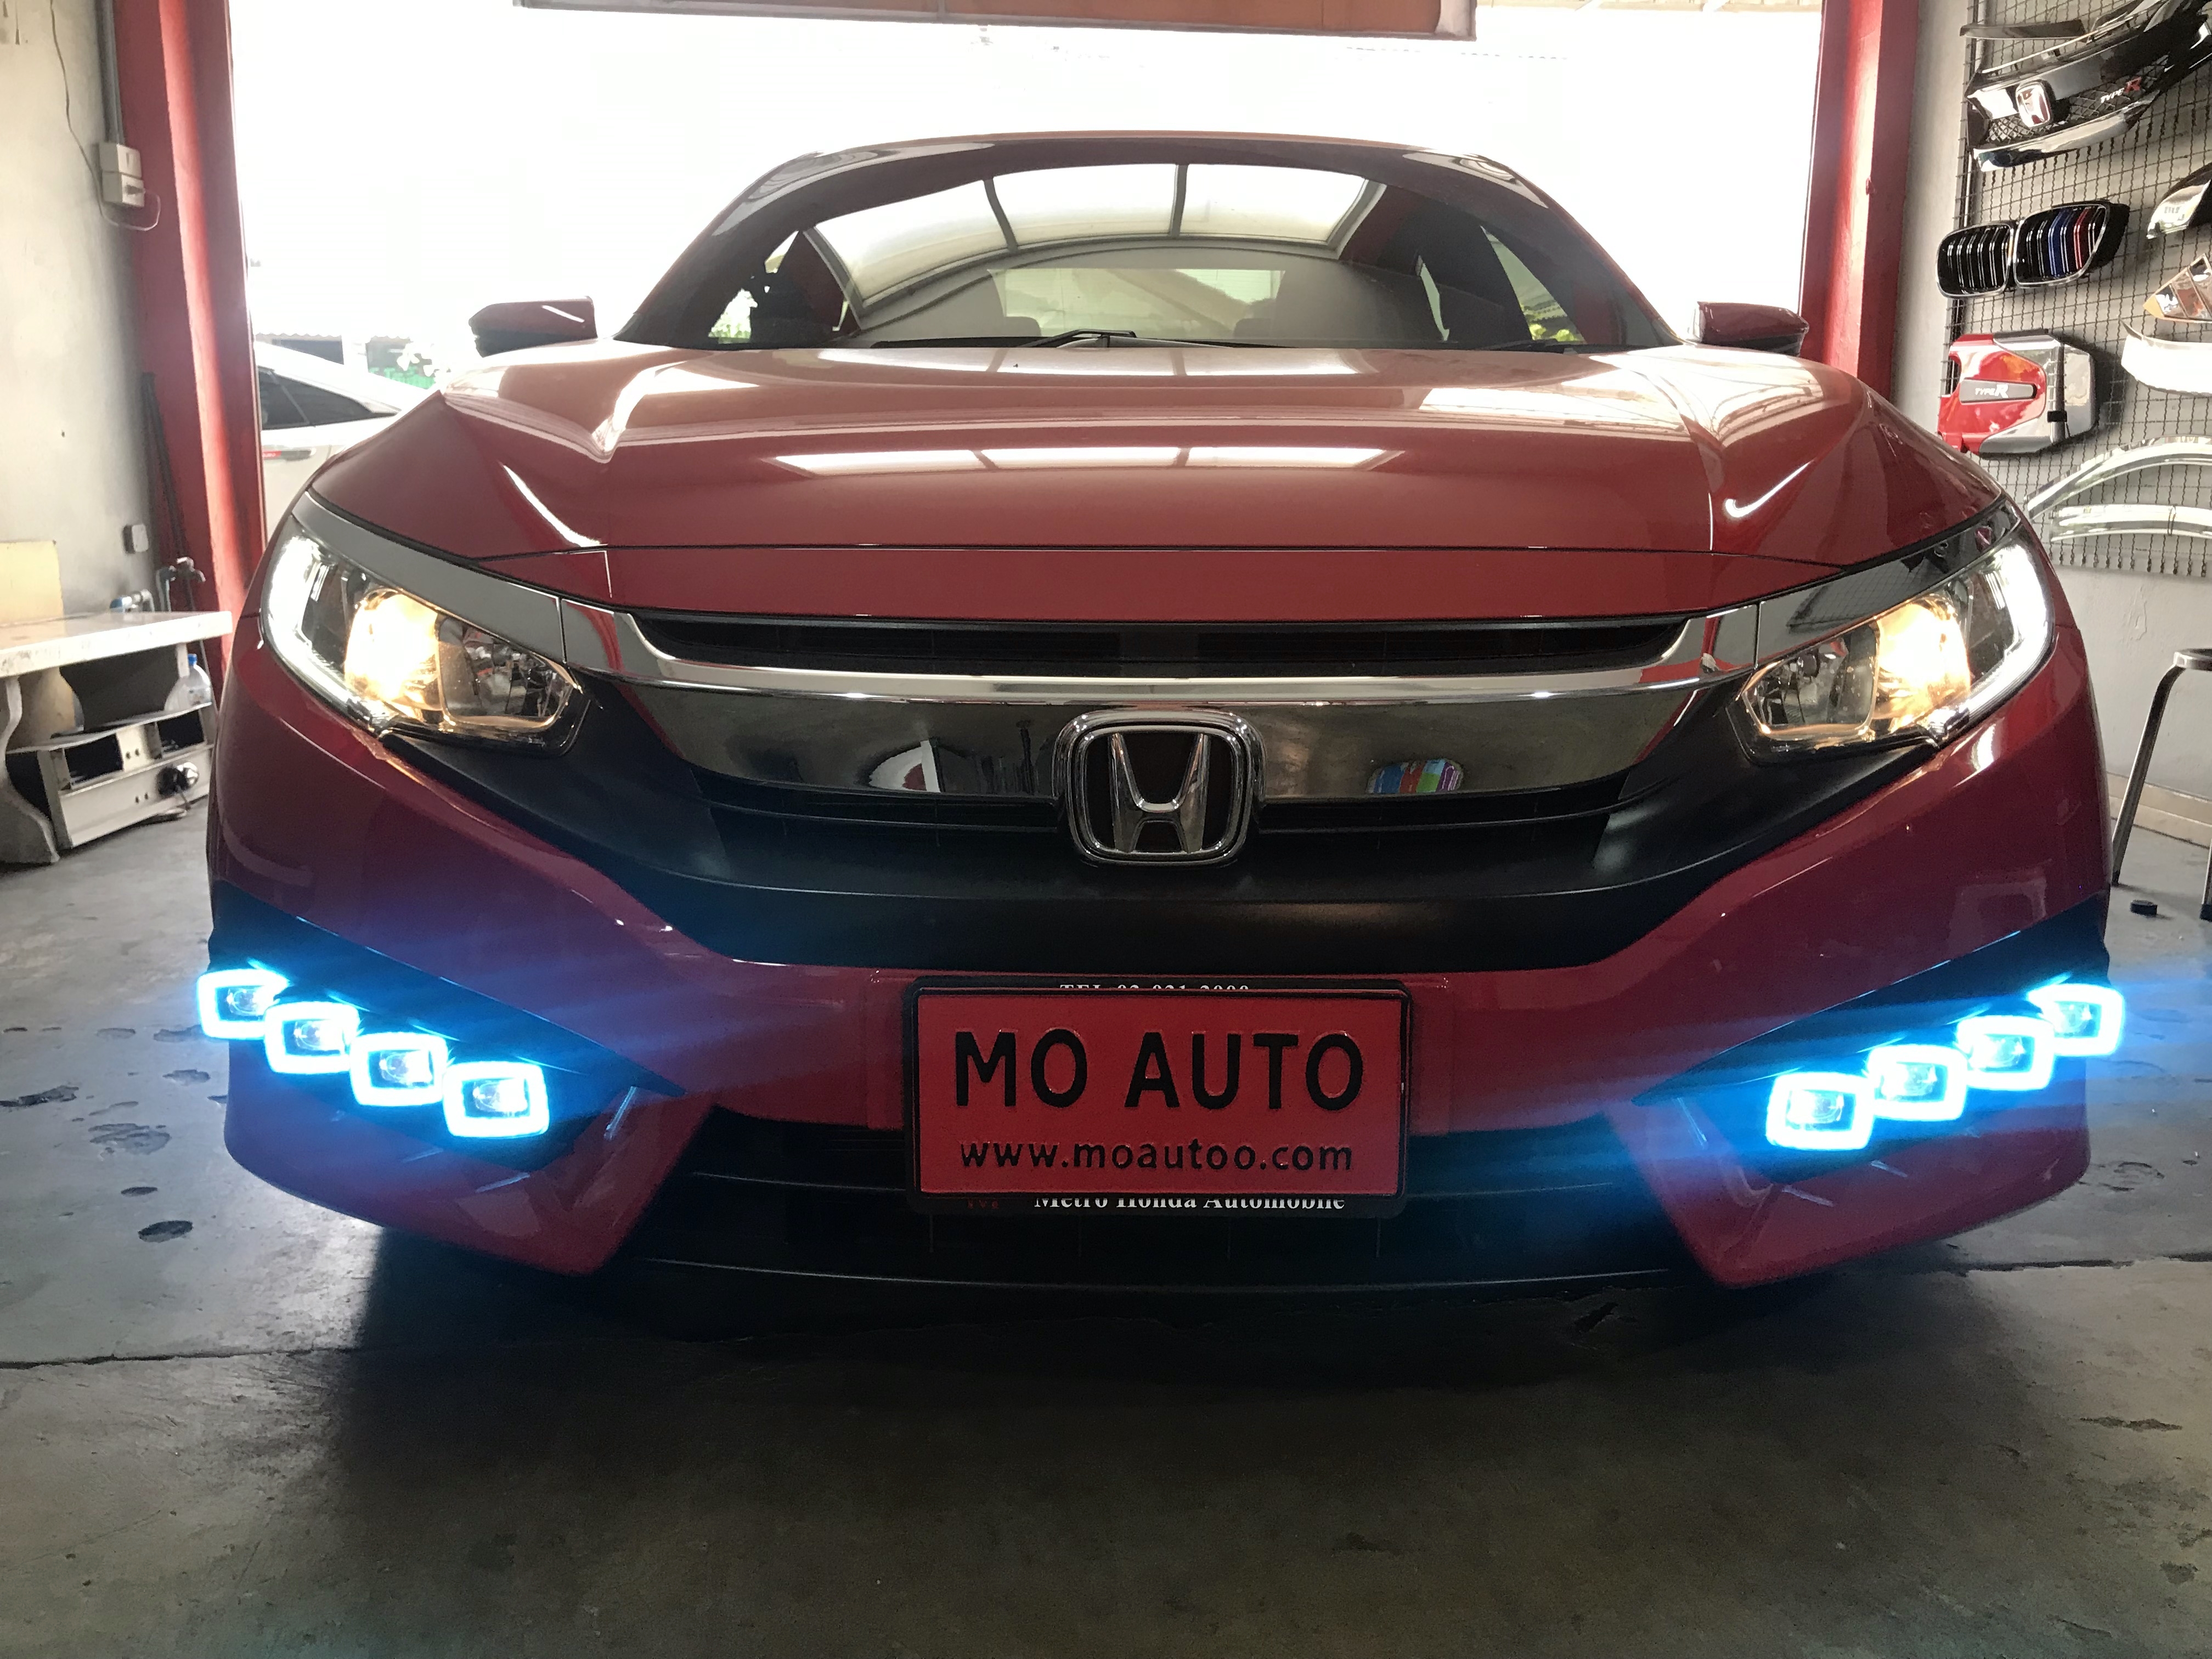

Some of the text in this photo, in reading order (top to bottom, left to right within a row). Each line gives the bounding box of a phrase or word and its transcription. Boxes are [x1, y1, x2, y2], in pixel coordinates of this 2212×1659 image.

[955, 1028, 1364, 1111] MO AUTO
[960, 1138, 1352, 1170] www.moautoo.com
